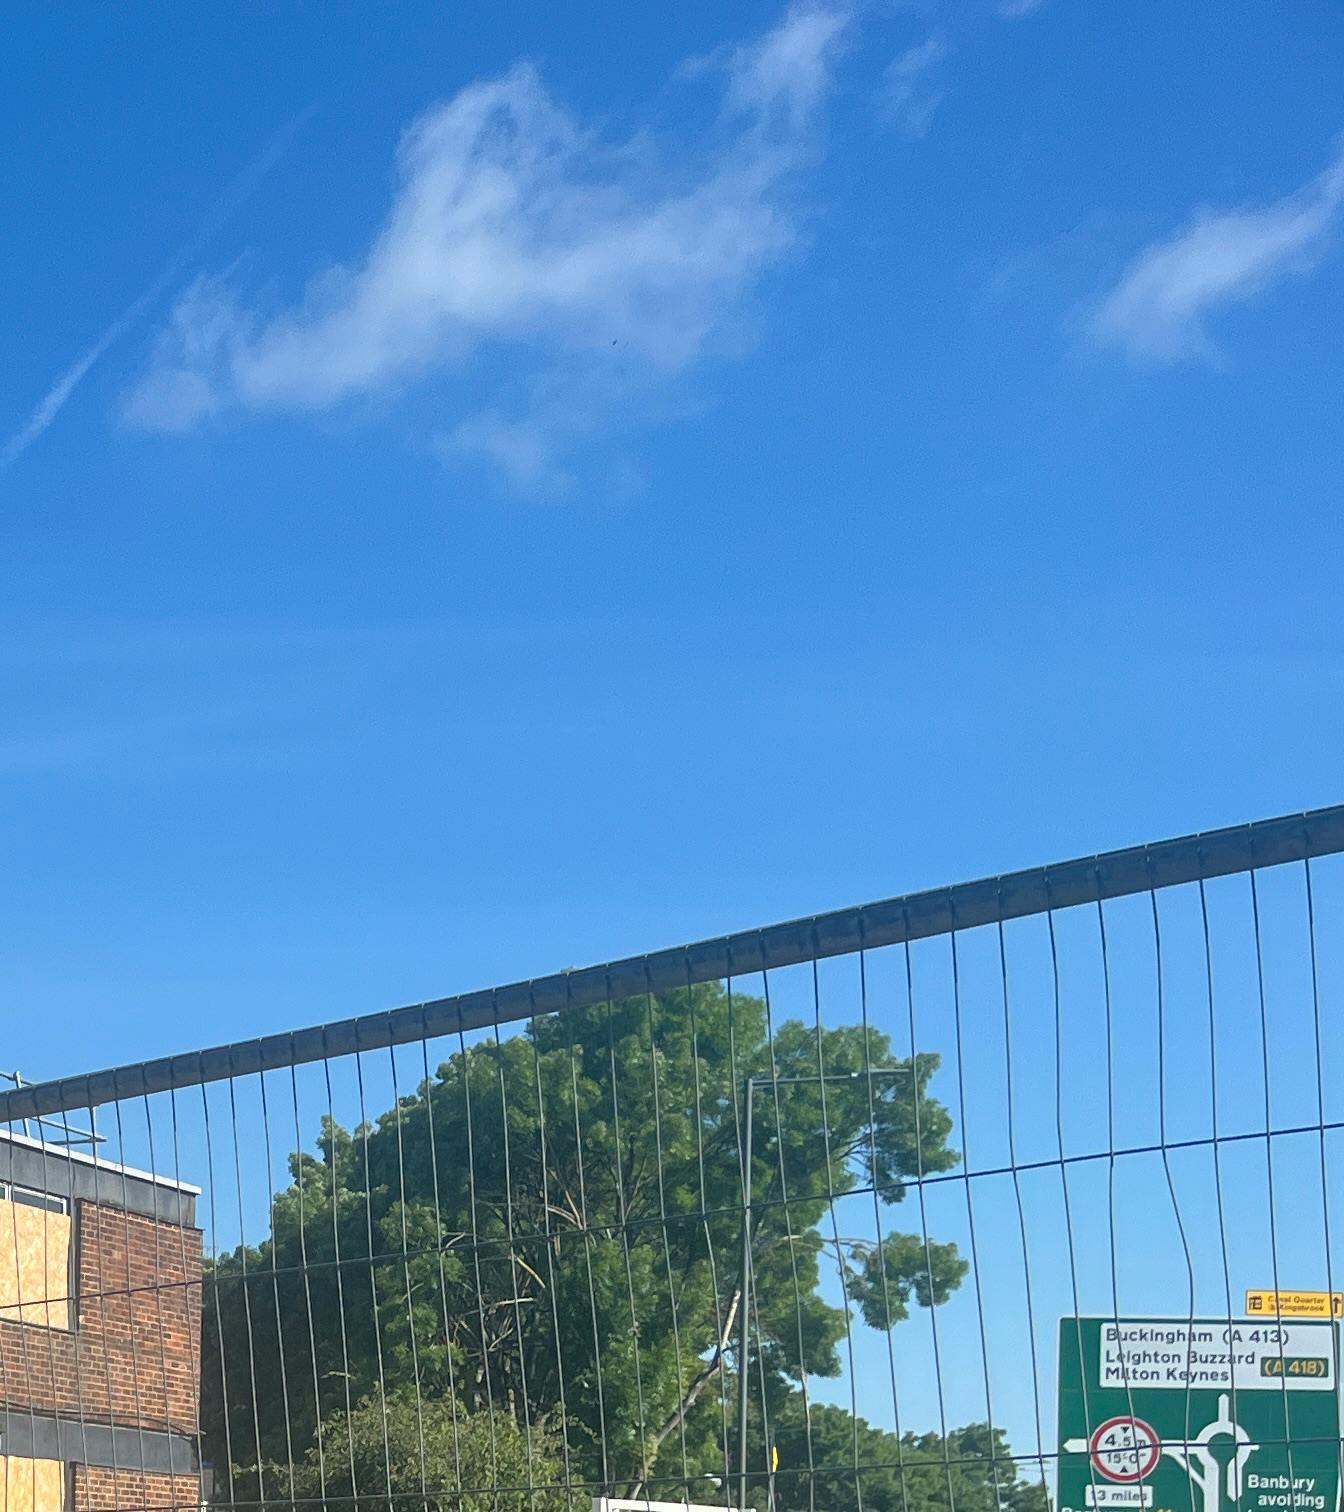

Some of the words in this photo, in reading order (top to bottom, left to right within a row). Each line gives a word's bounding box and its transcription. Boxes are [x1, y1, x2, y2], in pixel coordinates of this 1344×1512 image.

[1106, 1328, 1213, 1344] Buckingham
[1223, 1329, 1242, 1345] (A
[1249, 1329, 1289, 1345] 413)
[1106, 1350, 1181, 1365] Leighton
[1188, 1351, 1255, 1365] Buzzard
[1264, 1359, 1283, 1376] (A
[1289, 1359, 1325, 1376] 418)
[1167, 1368, 1229, 1383] Keynes
[1104, 1434, 1131, 1447] 4.5
[1248, 1474, 1315, 1491] Banbury
[1112, 1490, 1148, 1501] miles
[1258, 1493, 1325, 1509] avoiding
